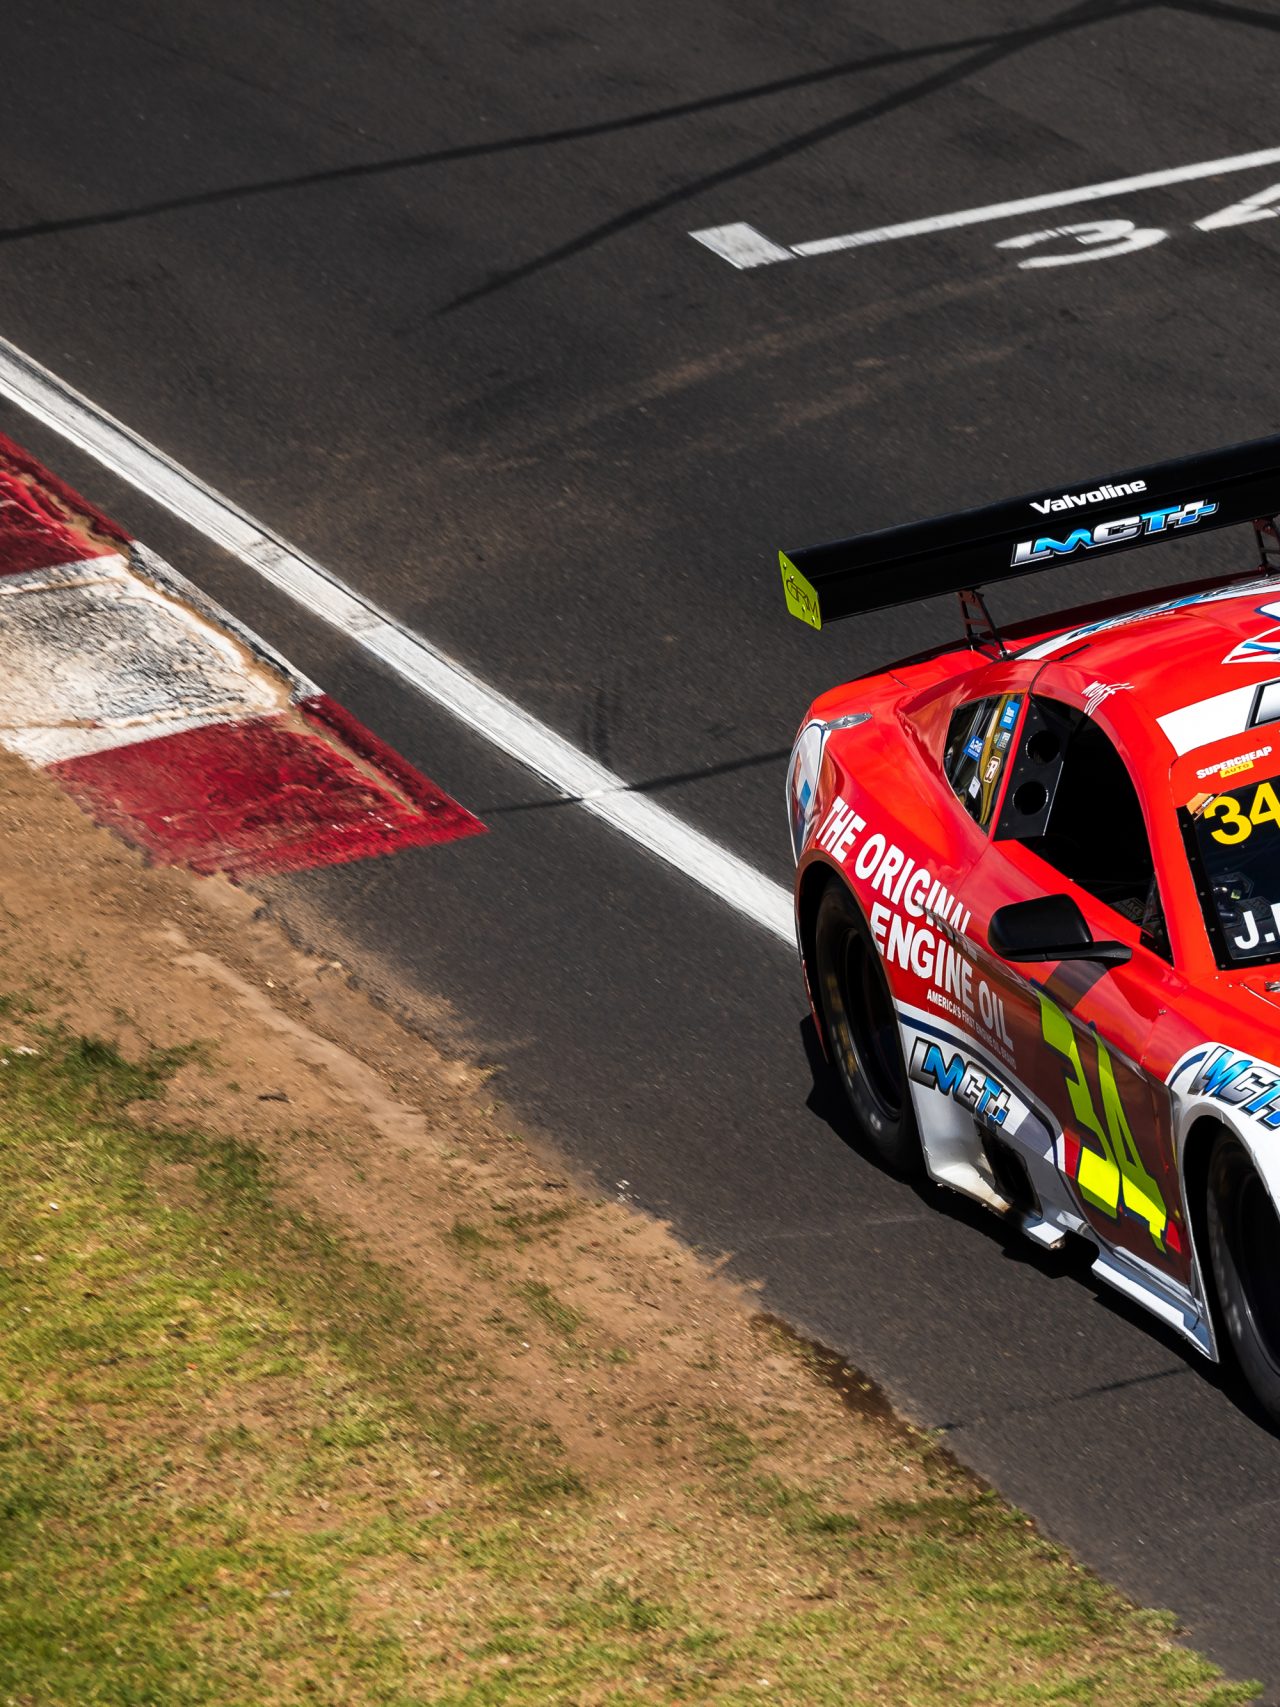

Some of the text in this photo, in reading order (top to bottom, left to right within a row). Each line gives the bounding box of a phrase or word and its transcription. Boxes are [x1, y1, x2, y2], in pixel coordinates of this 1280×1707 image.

[1029, 479, 1148, 515] Valvoline
[1196, 746, 1273, 779] SUPERCHEAP
[1224, 763, 1250, 775] AUTO
[816, 796, 978, 961] THE ORIGINAL
[870, 901, 1014, 1052] ENGINE OIL
